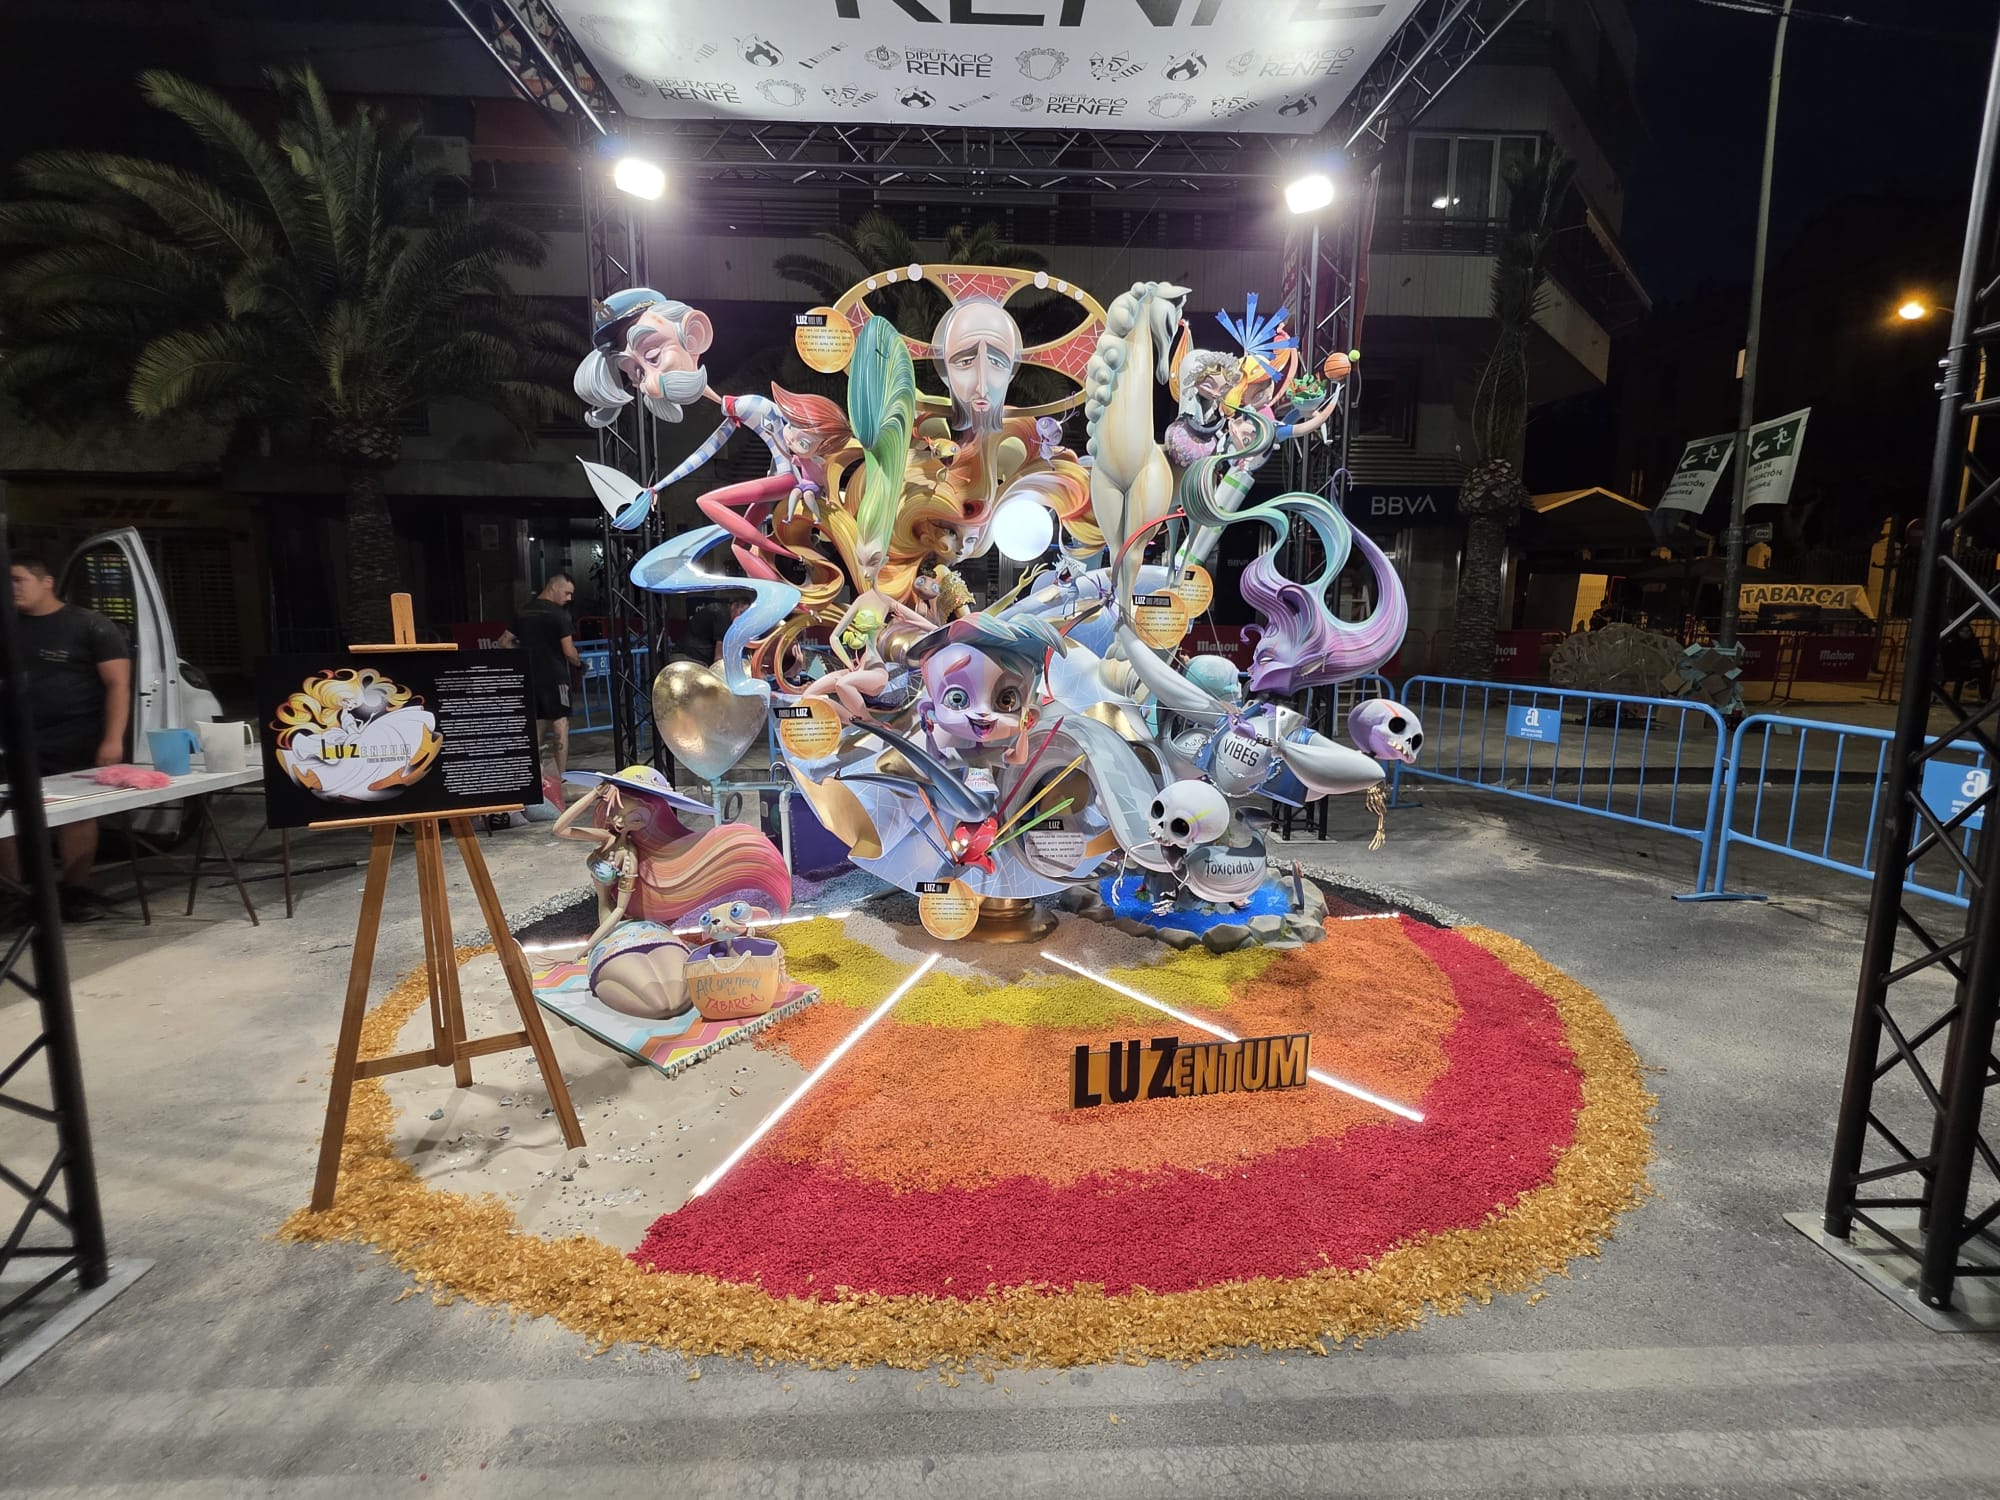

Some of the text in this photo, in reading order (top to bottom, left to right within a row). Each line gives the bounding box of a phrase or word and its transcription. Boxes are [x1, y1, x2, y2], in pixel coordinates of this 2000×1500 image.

[905, 51, 993, 63] DIPUTACIÓ
[906, 60, 992, 78] RENFE
[1259, 58, 1349, 77] RENFE
[652, 79, 737, 92] DIPUTACIÓ
[657, 87, 742, 104] RENFE
[1048, 96, 1128, 106] DIPUTACIÓ
[1046, 103, 1125, 117] RENFE
[1370, 494, 1437, 515] BBVA
[1742, 587, 1847, 607] TABARCA
[1495, 643, 1518, 656] hou
[1223, 738, 1260, 767] VIBES
[1048, 820, 1061, 830] LUZ
[1204, 858, 1255, 878] Toxicidad
[705, 992, 765, 1011] TABARCA
